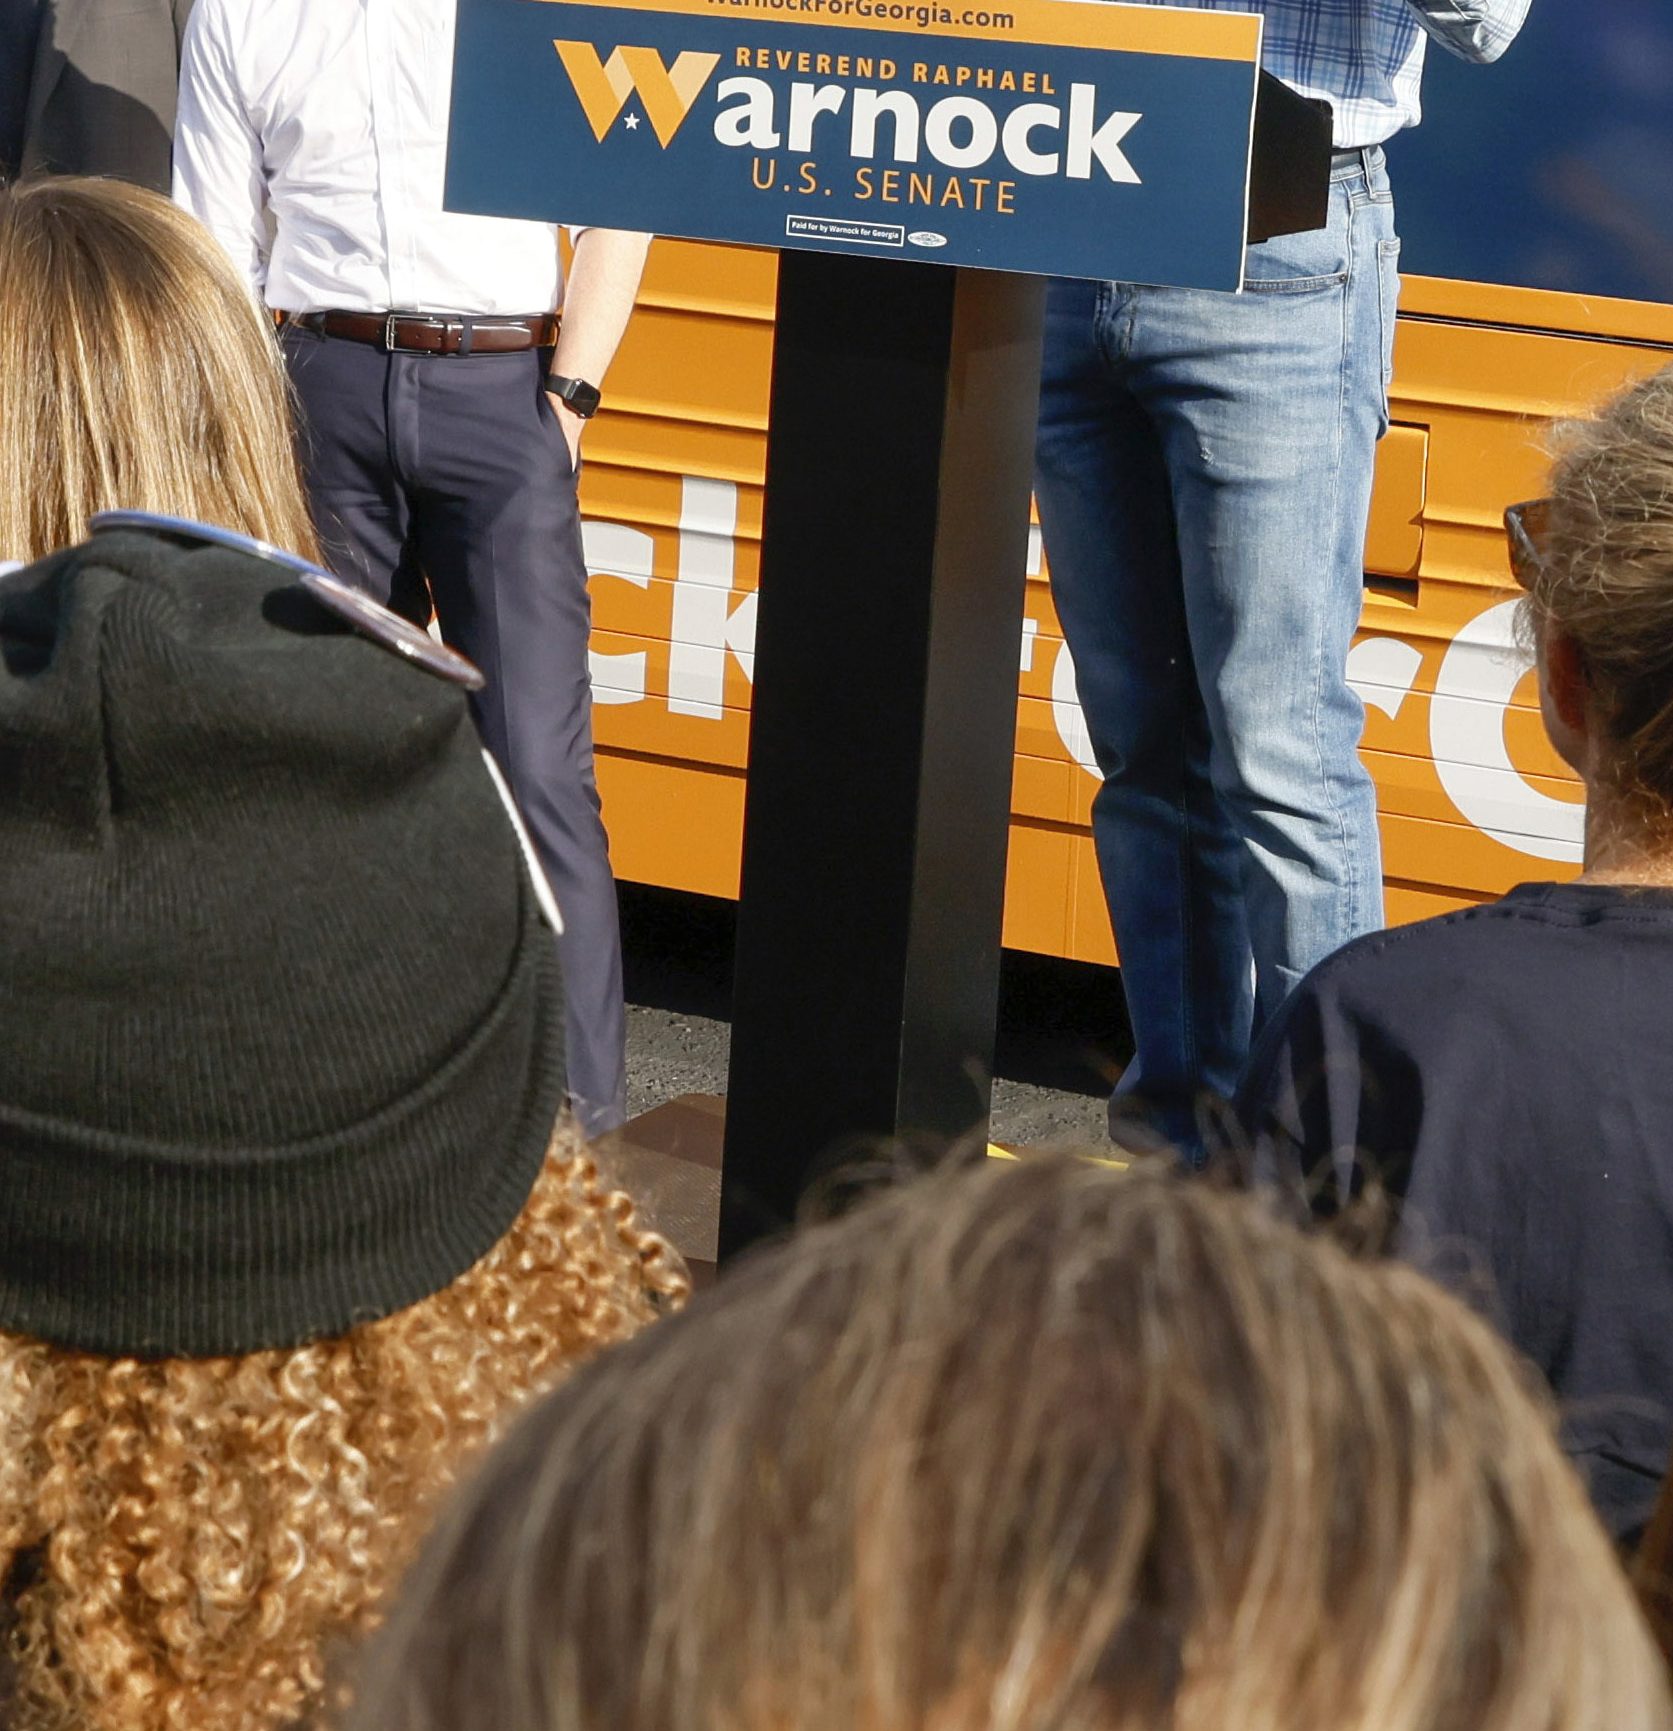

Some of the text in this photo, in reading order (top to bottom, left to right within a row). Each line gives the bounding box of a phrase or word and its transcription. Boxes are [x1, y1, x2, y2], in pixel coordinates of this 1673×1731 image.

[736, 46, 1056, 95] REVEREND RAPHAEL
[552, 39, 1144, 185] Warnock
[751, 156, 1017, 214] U.S. SENATE
[791, 221, 807, 230] Paid
[808, 222, 818, 232] for
[819, 223, 829, 234] by
[829, 225, 860, 236] Warnock
[860, 227, 871, 237] for
[872, 228, 900, 240] Georgia
